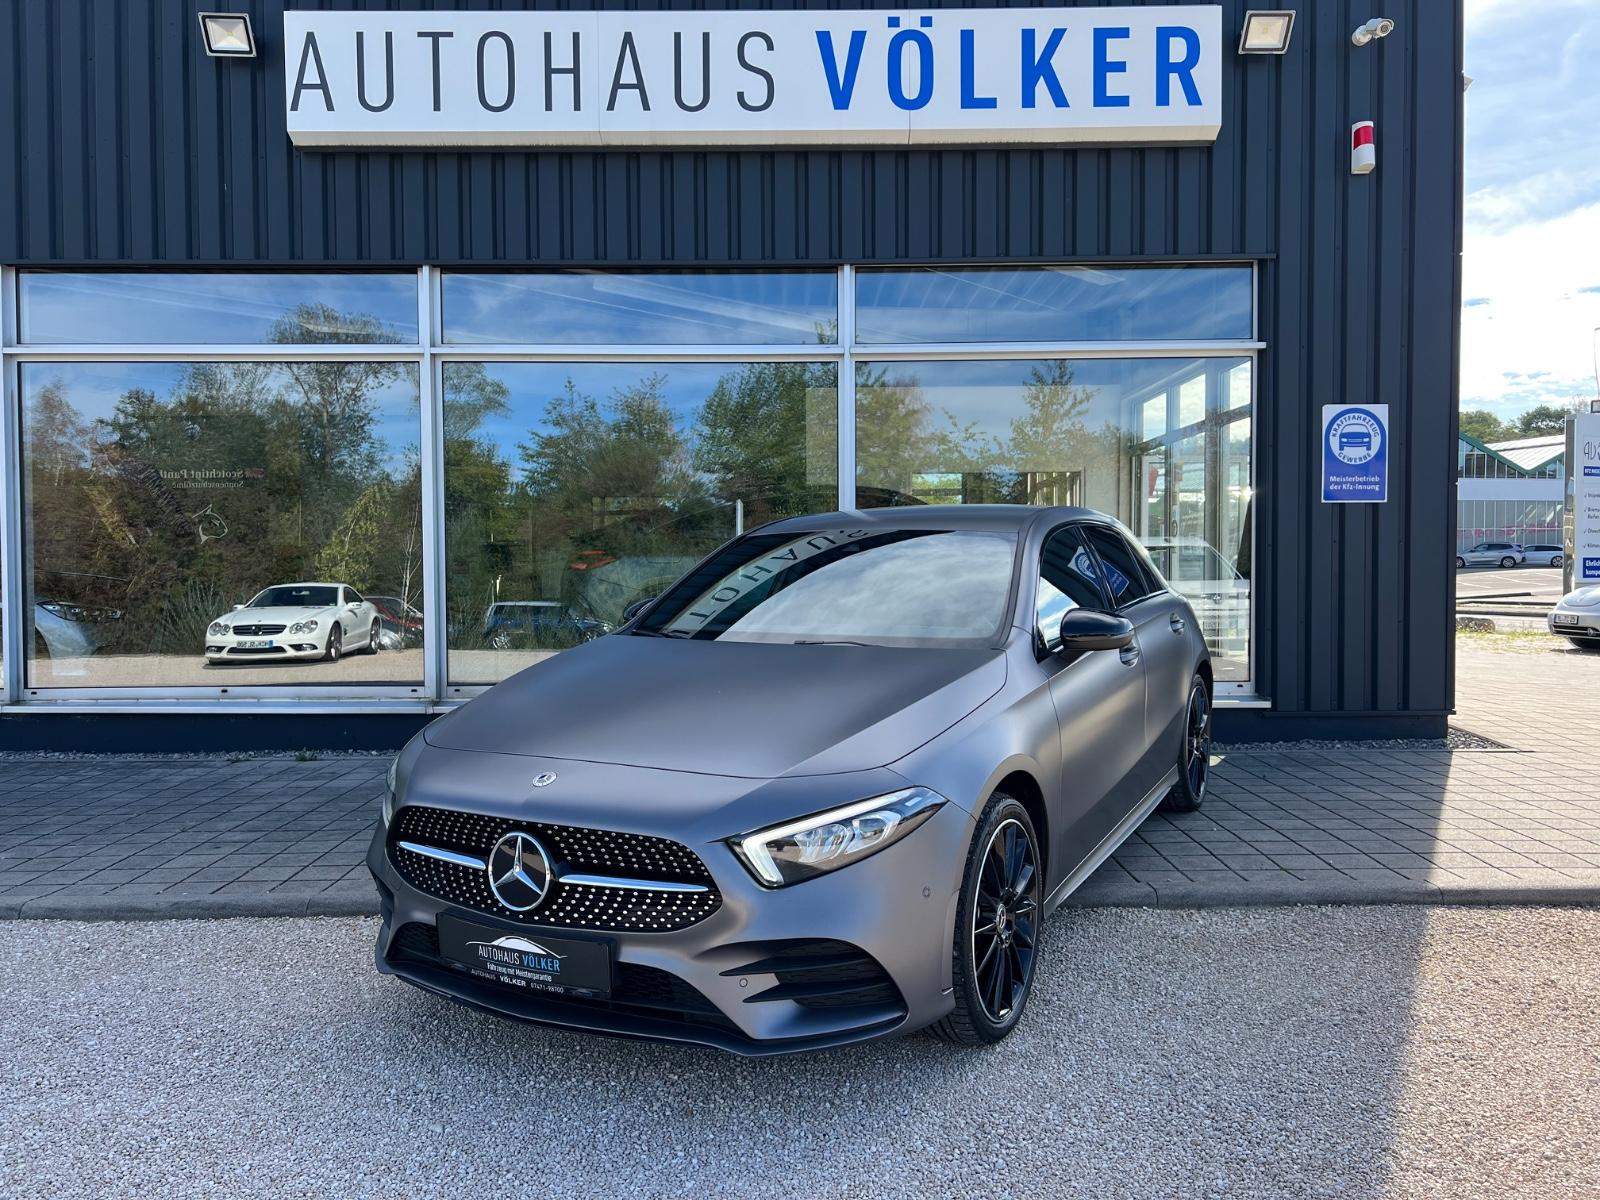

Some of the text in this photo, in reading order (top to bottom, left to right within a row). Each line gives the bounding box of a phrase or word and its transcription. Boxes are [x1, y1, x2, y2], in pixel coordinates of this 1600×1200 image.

[289, 16, 1203, 112] AUTOHAUS VÖLKER
[1332, 414, 1379, 438] KRAFTFAHRZEUG
[1338, 451, 1372, 463] GEWERBE
[1342, 483, 1380, 491] Kfz-Innung
[478, 945, 560, 972] AUTOHAUS VÖLKER
[487, 962, 507, 974] Fahrzeug
[471, 968, 496, 980] AUTOHAUS
[499, 975, 526, 988] VÖLKER
